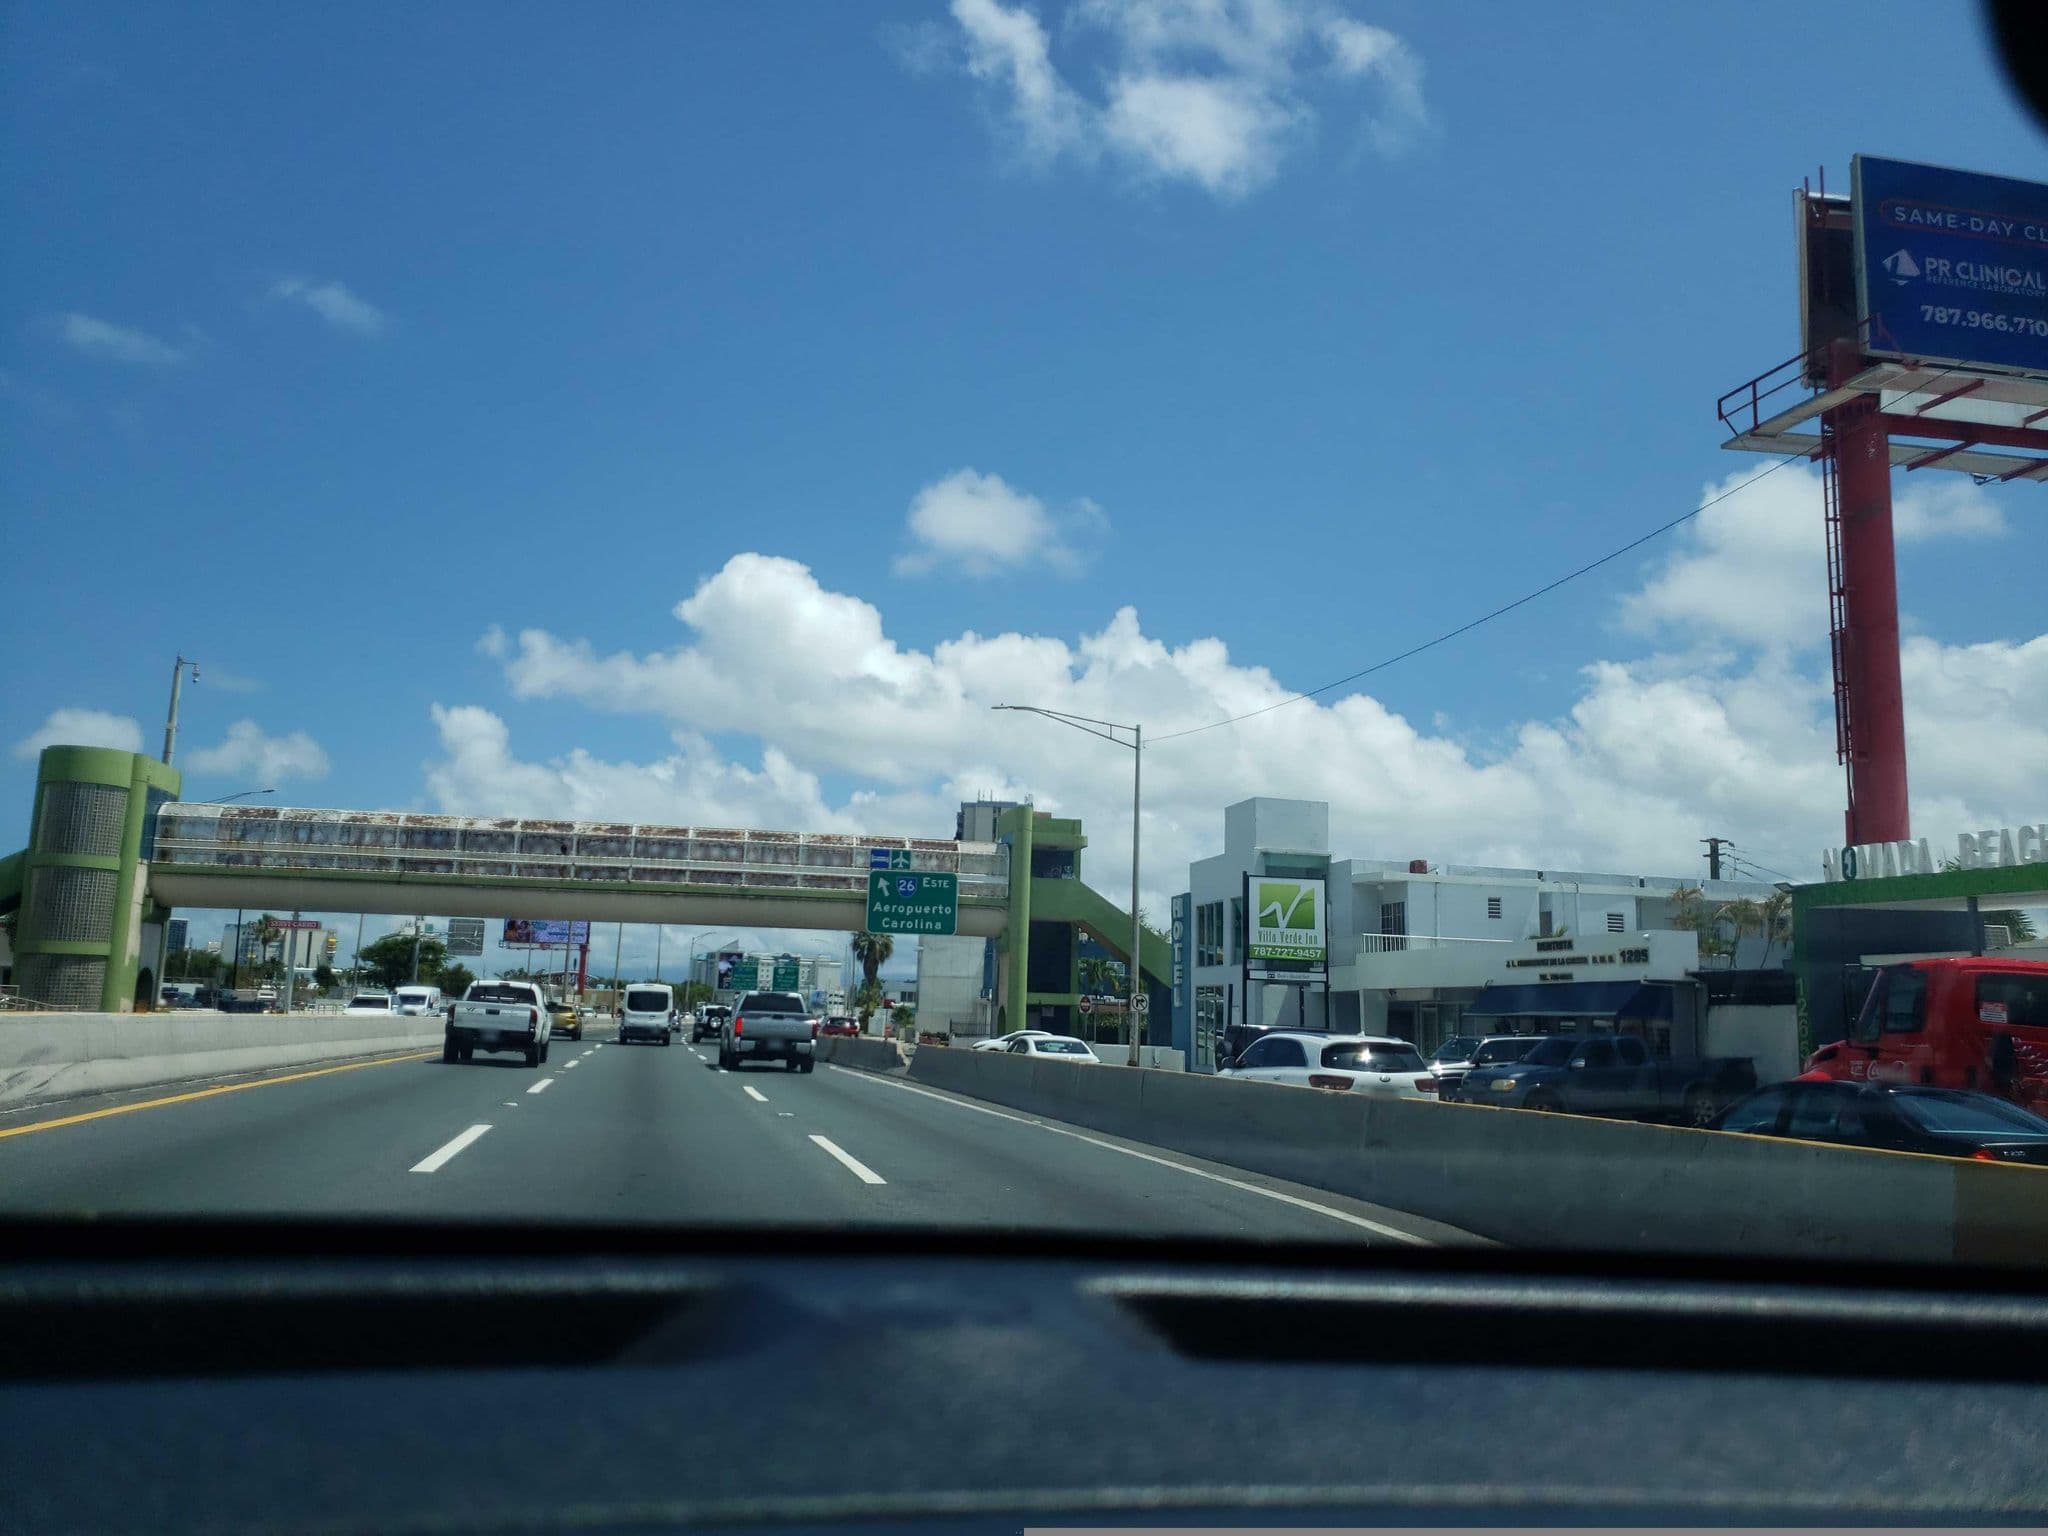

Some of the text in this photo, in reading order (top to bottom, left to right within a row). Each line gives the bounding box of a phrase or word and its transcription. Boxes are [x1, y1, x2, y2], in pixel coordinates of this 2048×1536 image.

[1895, 206, 2014, 236] SAME-DAY
[1925, 256, 2046, 290] PR CLINICAL
[1823, 837, 1934, 882] NOMADA
[899, 880, 915, 891] 26
[872, 902, 952, 916] Aeropuerto
[882, 917, 942, 930] Carolina
[1257, 930, 1277, 943] Villa
[1280, 931, 1303, 944] Verde
[1172, 898, 1184, 1008] HOTEL
[1253, 947, 1322, 958] 787-727-9457
